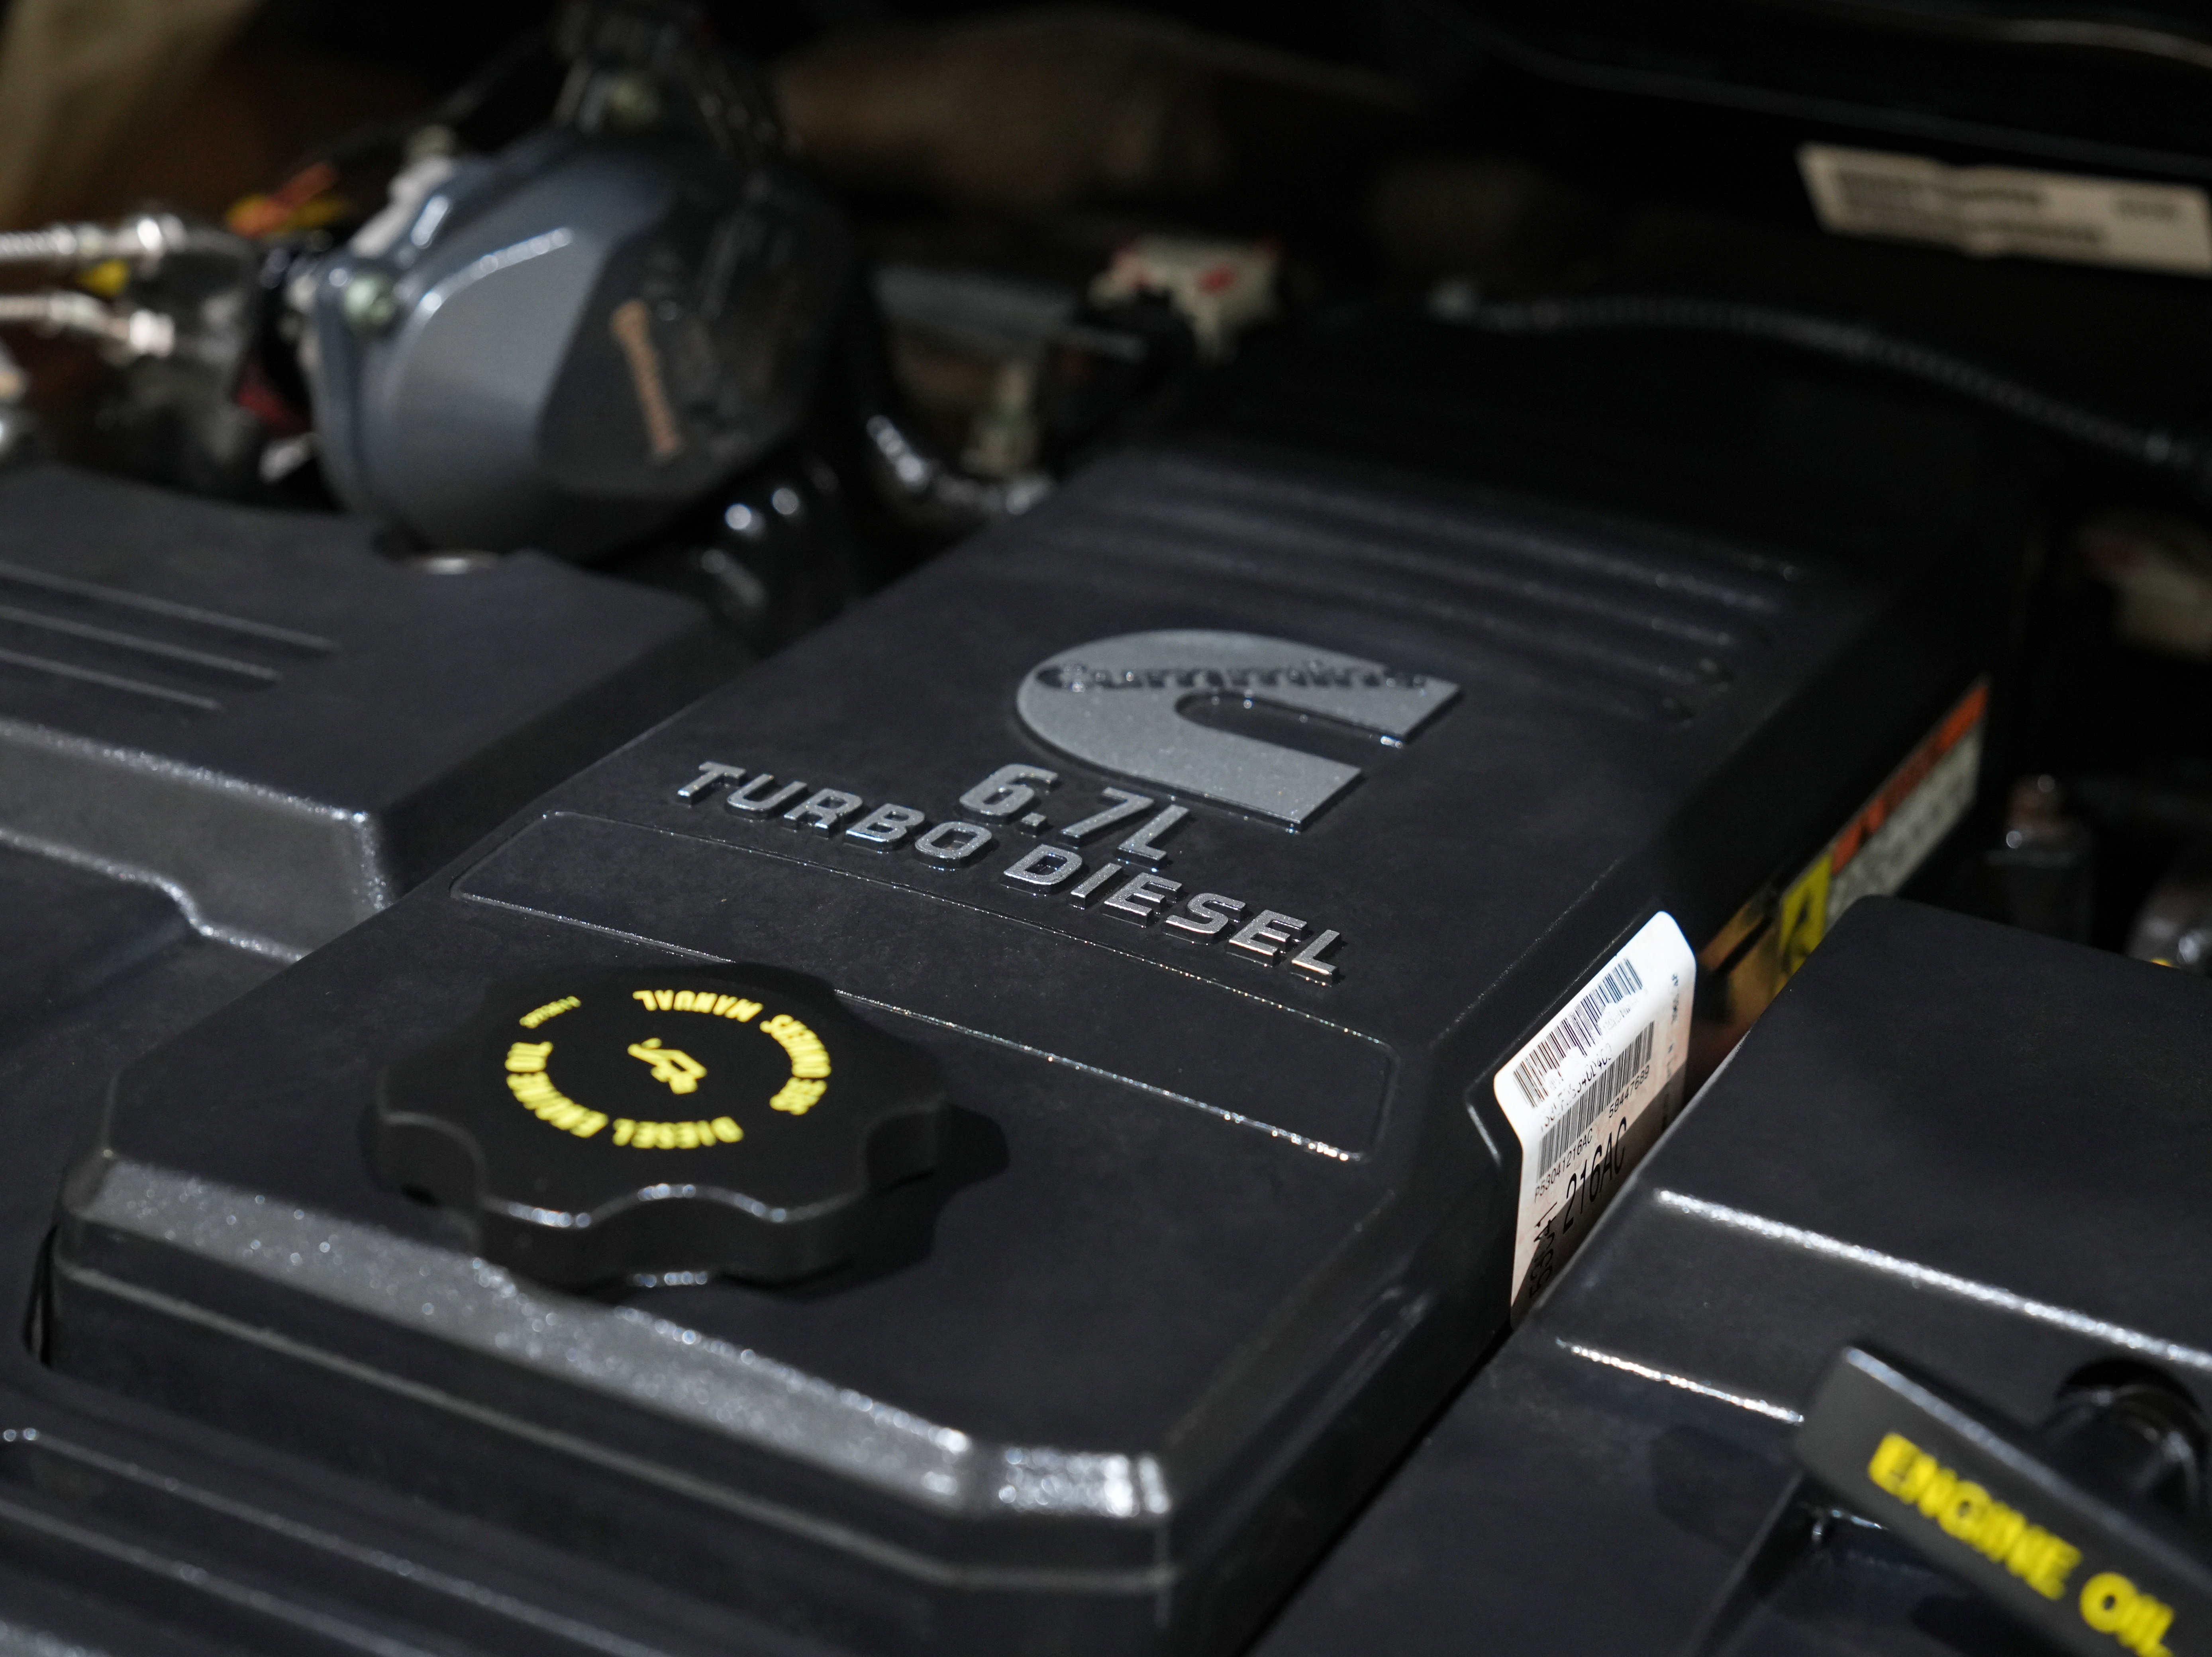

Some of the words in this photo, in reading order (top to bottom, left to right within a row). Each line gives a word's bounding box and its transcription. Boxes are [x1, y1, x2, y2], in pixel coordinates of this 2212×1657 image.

[677, 760, 993, 865] TURBO
[959, 763, 1190, 869] 6.7L
[1002, 844, 1342, 982] DIESEL
[633, 989, 763, 1023] MANUAL
[1563, 1116, 1627, 1235] 216AC
[1868, 1432, 2080, 1600] ENGINE
